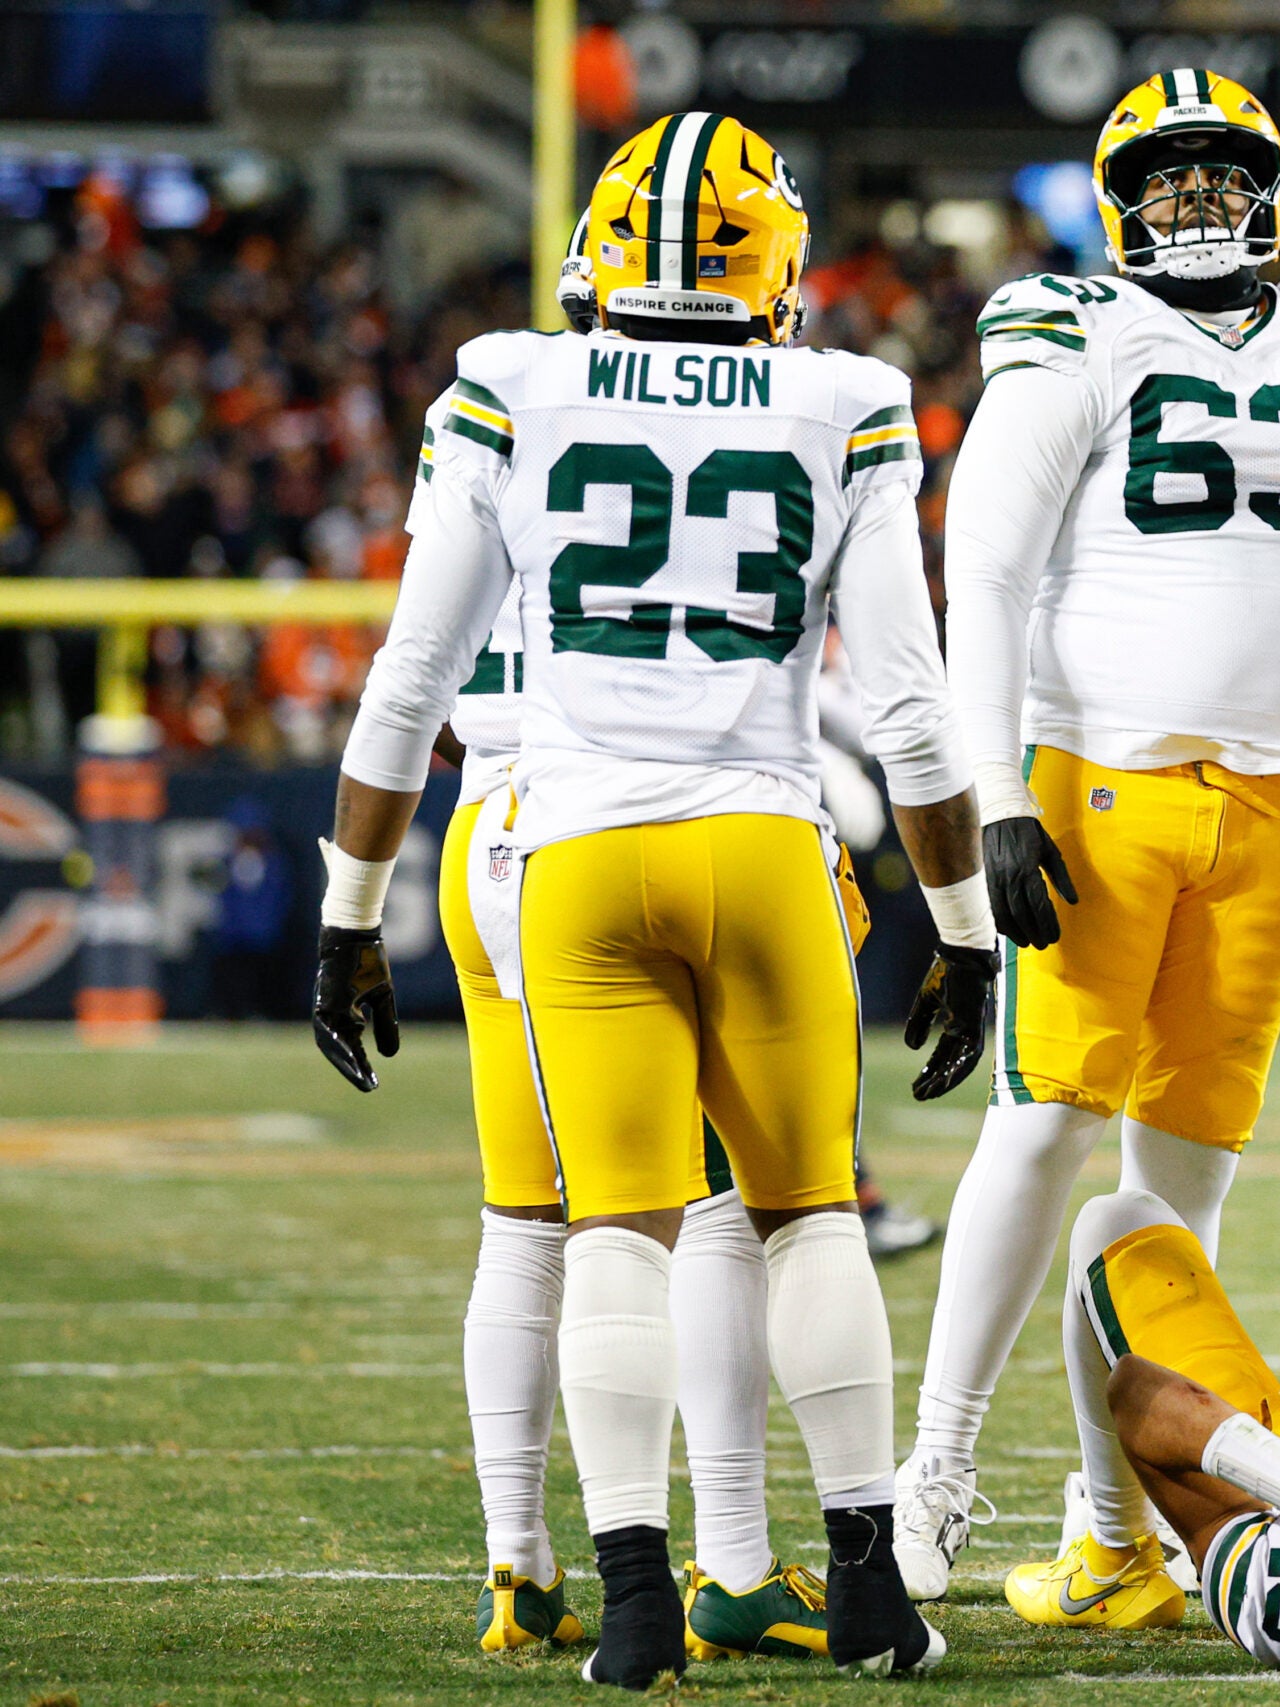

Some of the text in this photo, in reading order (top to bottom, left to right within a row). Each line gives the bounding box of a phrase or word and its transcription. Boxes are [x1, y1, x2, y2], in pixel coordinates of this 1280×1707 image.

[1173, 107, 1207, 116] PACKERS
[615, 296, 735, 314] INSPIRE CHANGE
[588, 348, 771, 407] WILSON
[546, 442, 814, 664] 23
[496, 1572, 509, 1585] 11
